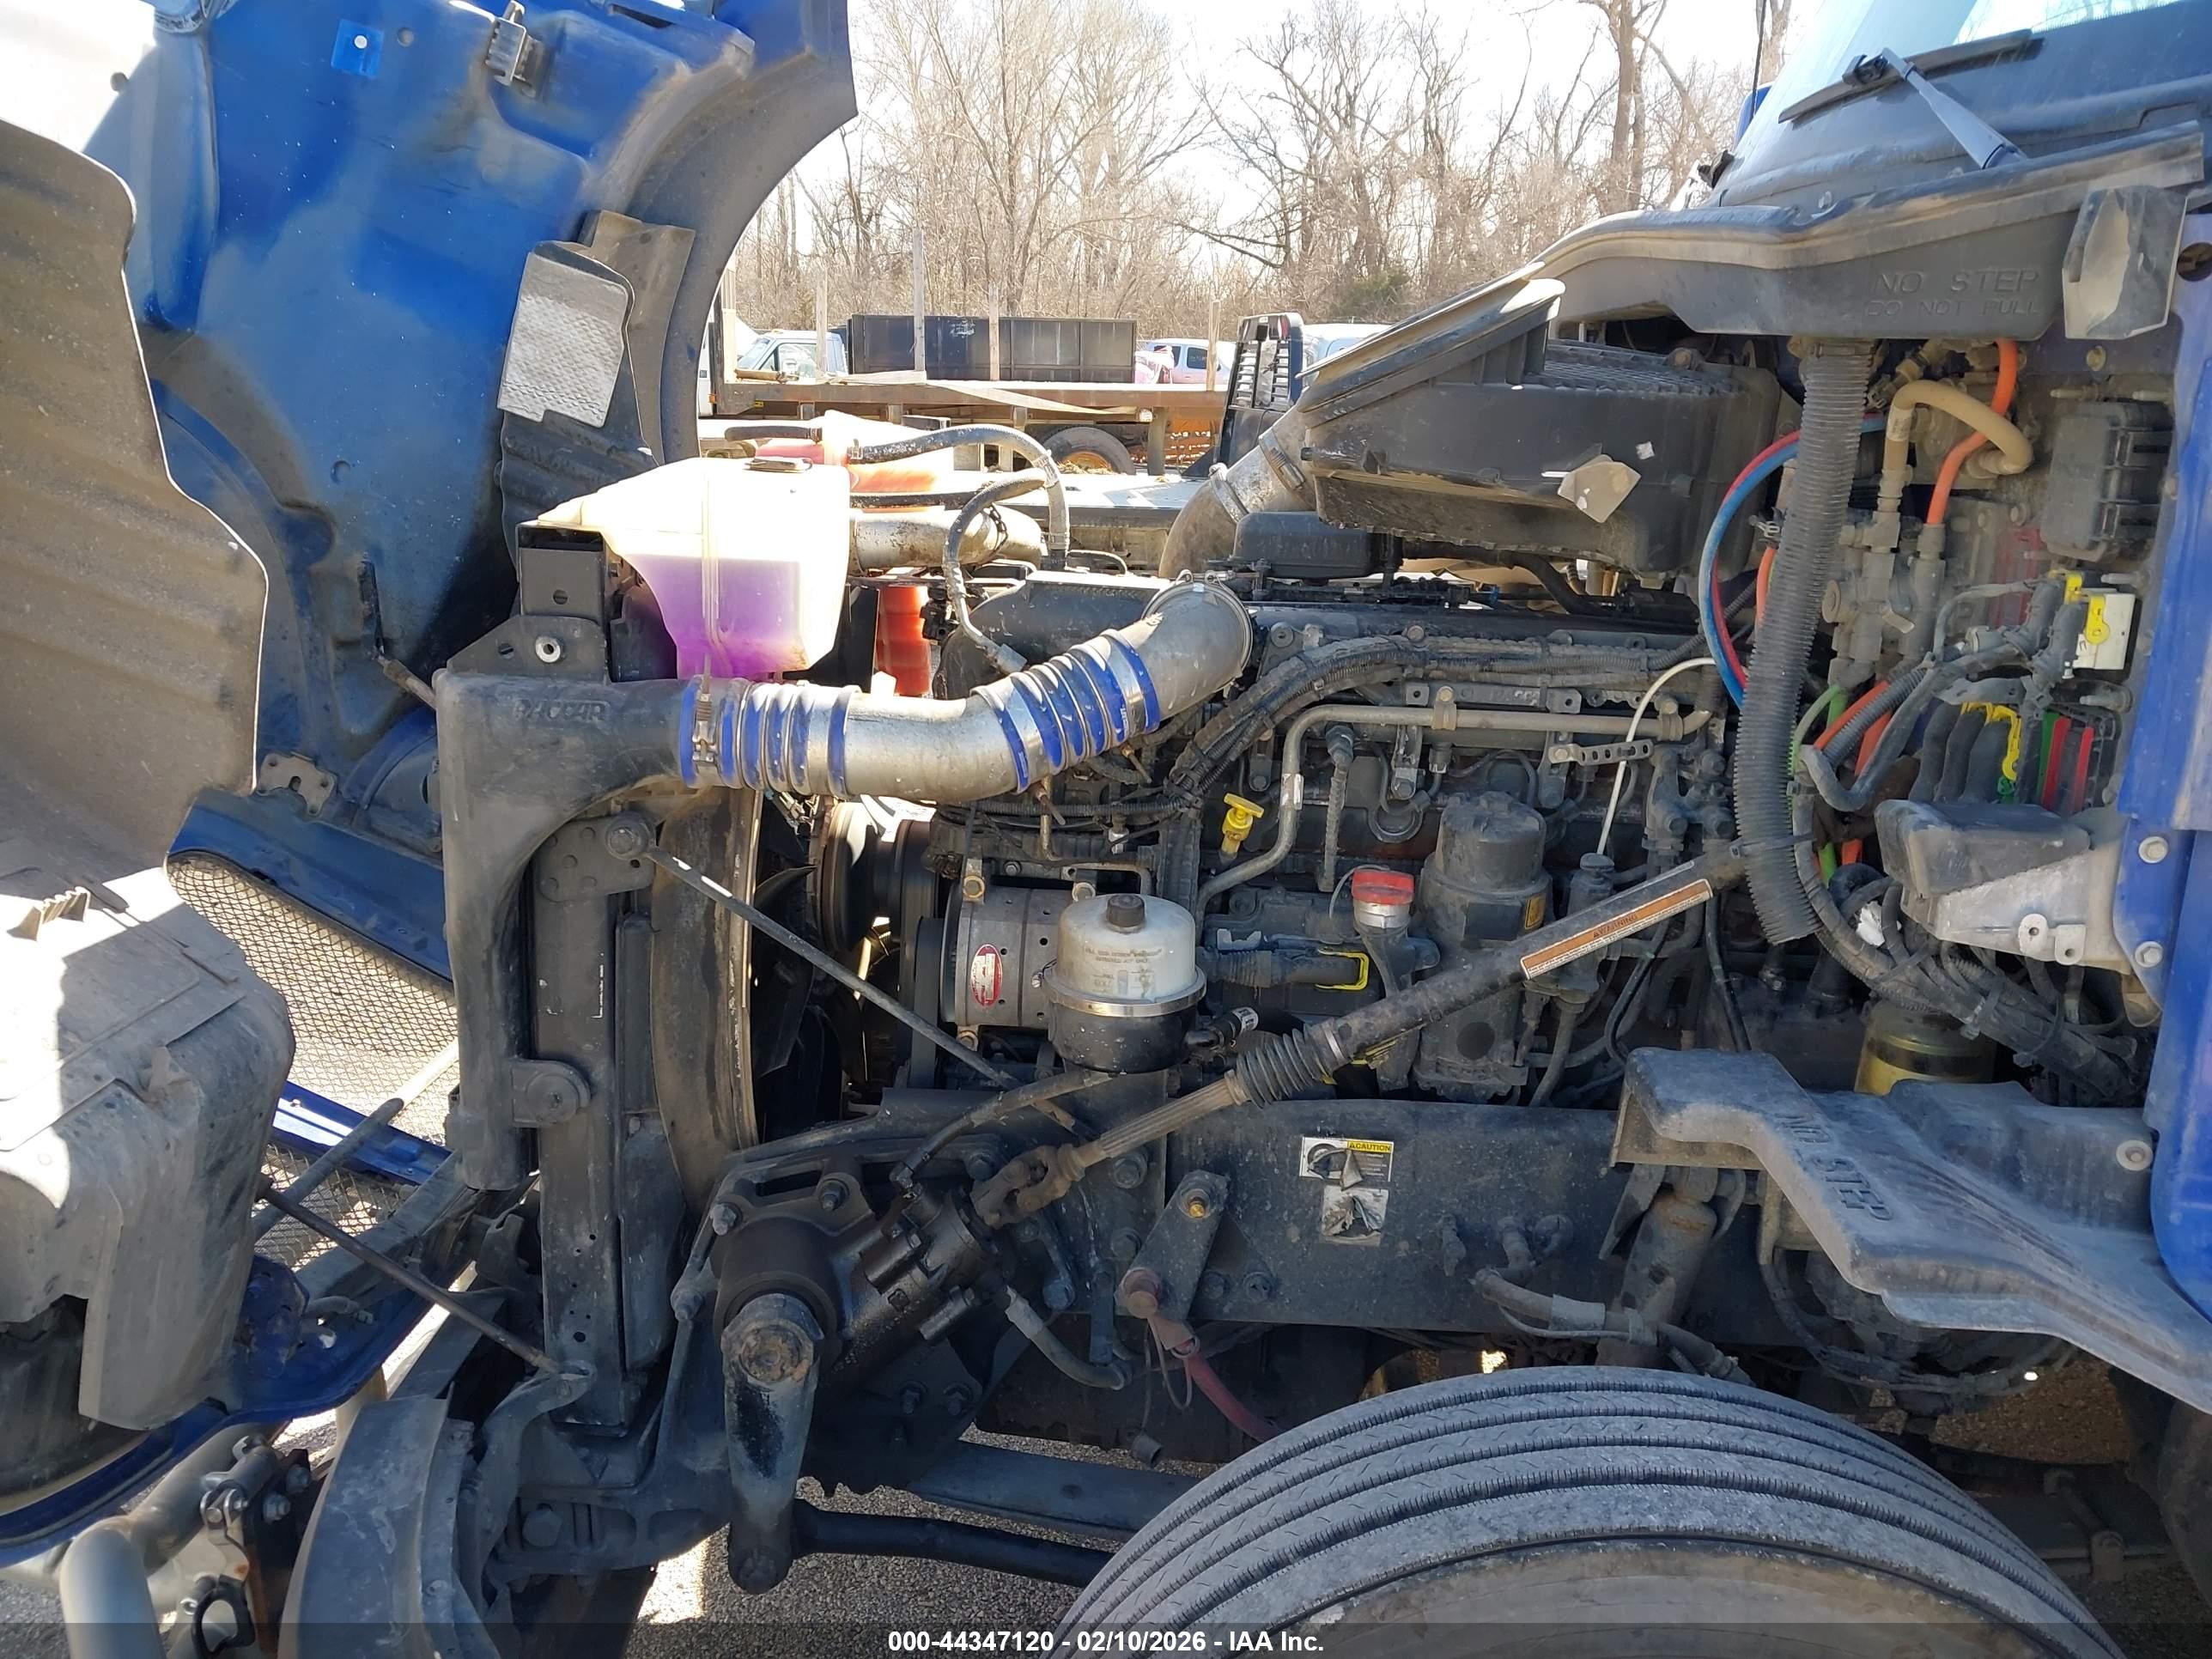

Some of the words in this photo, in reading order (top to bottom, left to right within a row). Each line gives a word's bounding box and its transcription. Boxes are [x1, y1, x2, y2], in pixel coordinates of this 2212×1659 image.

[1874, 271, 1924, 294] NO
[1950, 269, 2039, 293] STEP
[1865, 301, 1902, 318] DO
[1920, 300, 1967, 317] NOT
[1982, 299, 2040, 317] PULL
[1598, 913, 1638, 937] WARNING
[1774, 1113, 1831, 1143] NO
[1355, 1142, 1390, 1152] CAUTION
[1795, 1148, 1894, 1221] STEP
